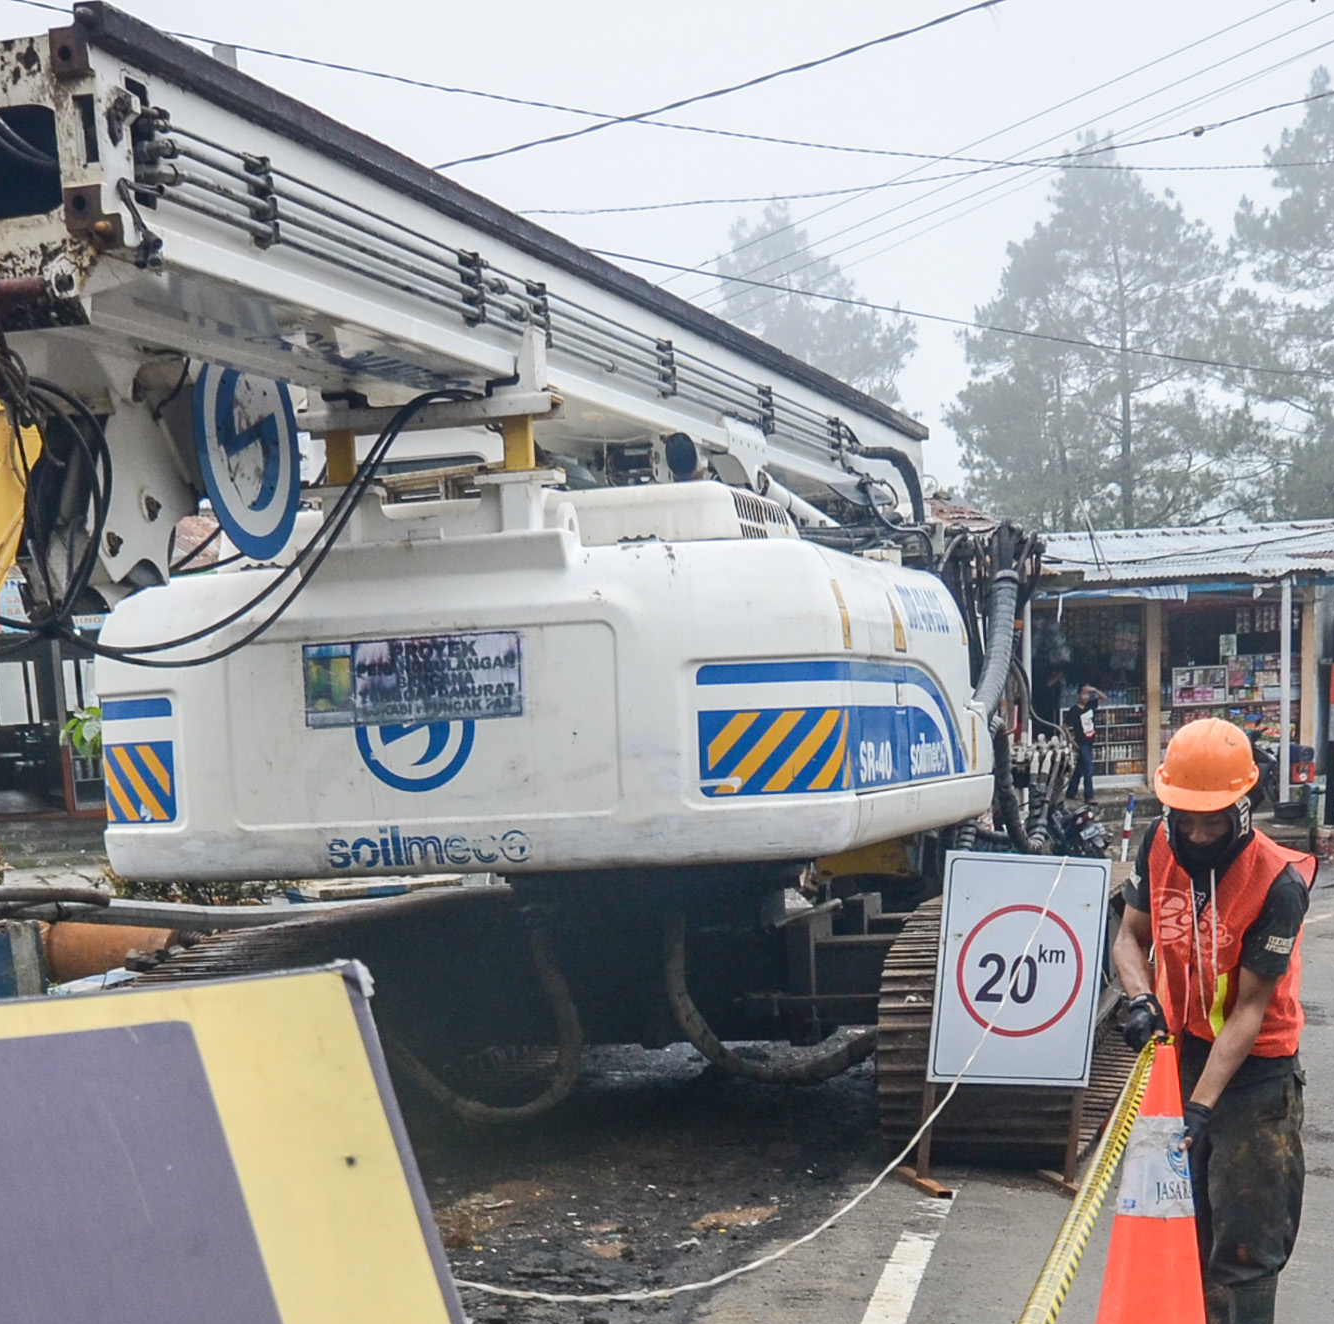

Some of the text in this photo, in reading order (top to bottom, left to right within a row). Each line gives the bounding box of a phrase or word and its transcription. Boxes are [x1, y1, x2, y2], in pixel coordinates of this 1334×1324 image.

[859, 740, 893, 783] SR-40
[326, 825, 499, 868] soilmec
[974, 944, 1066, 1004] 20 km
[1156, 1181, 1193, 1204] JASAR
